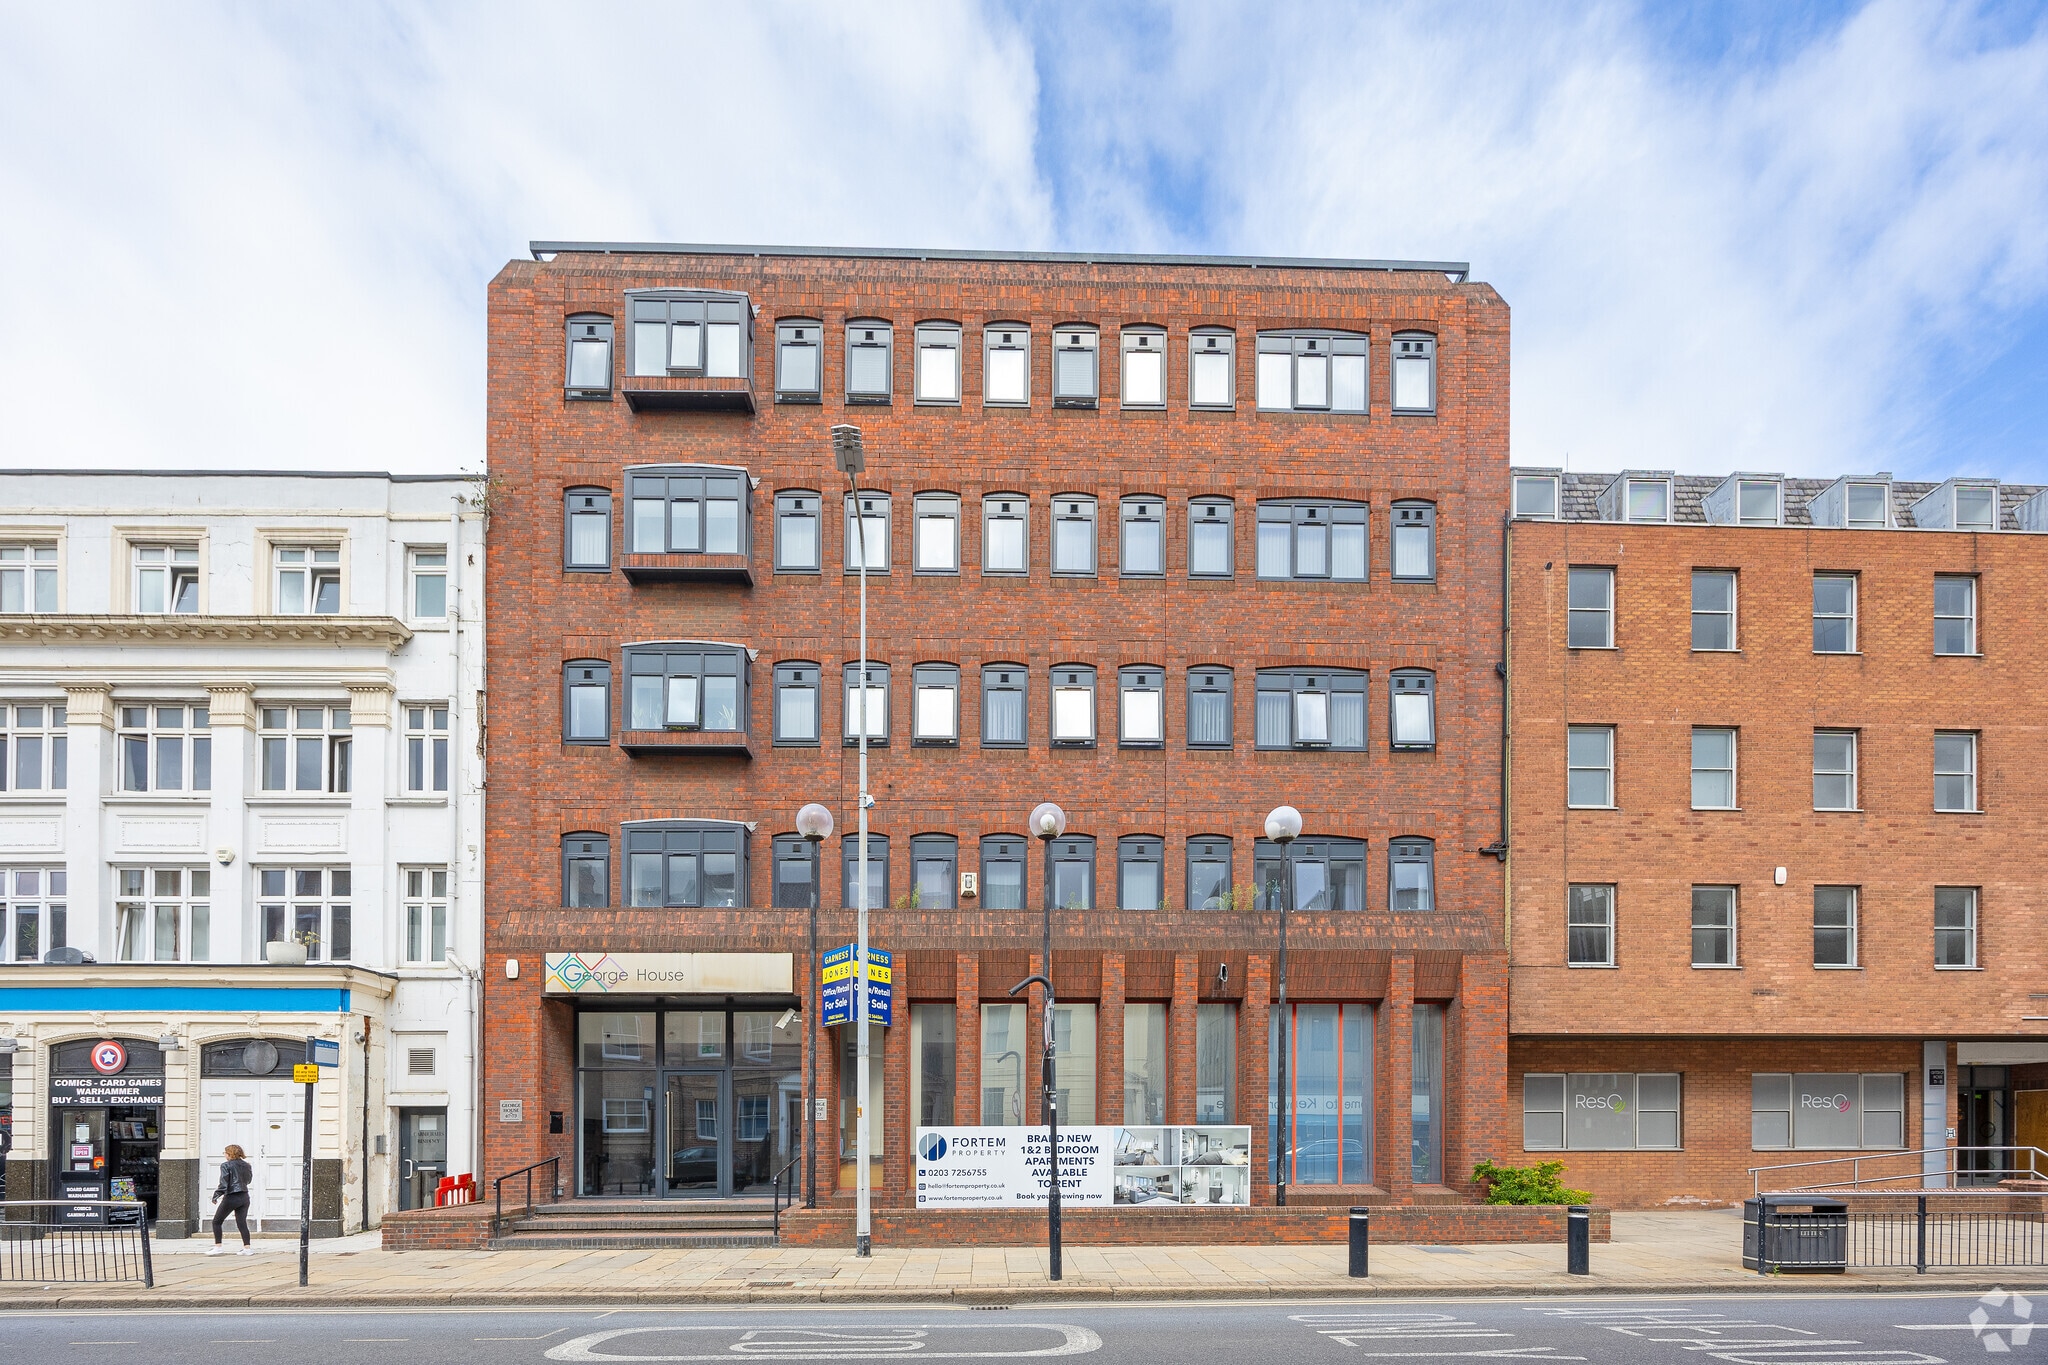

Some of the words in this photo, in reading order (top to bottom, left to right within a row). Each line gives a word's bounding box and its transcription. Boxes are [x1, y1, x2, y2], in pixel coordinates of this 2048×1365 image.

[824, 950, 849, 964] GARNESS
[856, 950, 888, 964] RNESS
[564, 964, 628, 984] George
[637, 968, 684, 982] House
[824, 966, 849, 980] JONES
[823, 984, 850, 997] Office/Retail
[854, 984, 890, 996] Oe/Retail
[824, 1001, 834, 1010] For
[835, 998, 848, 1008] Sale
[871, 999, 888, 1010] Sale
[952, 1138, 1006, 1147] FORTEM
[1025, 1157, 1095, 1165] APARMENTS
[728, 1327, 928, 1352] 20
[1286, 1313, 1589, 1361] ONLY
[1521, 1307, 1949, 1365] AHEAD
